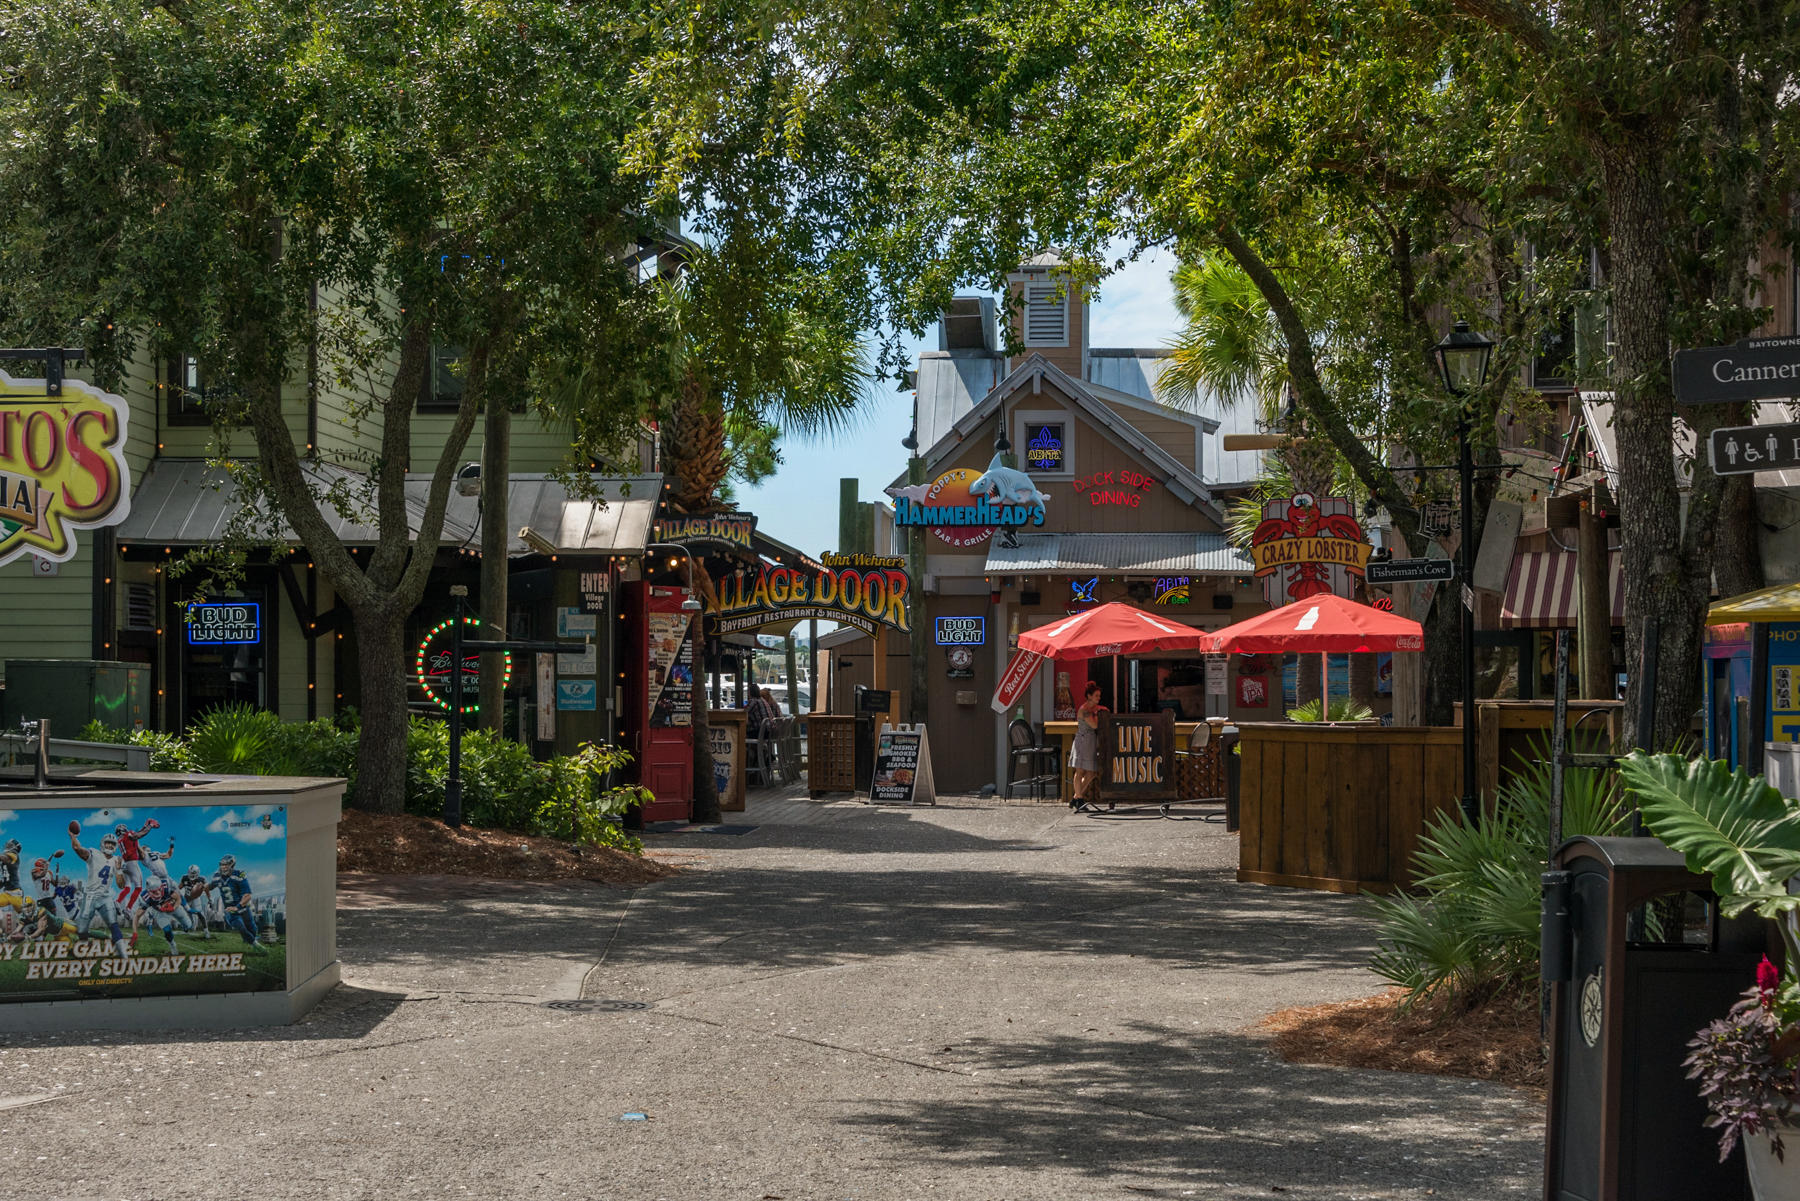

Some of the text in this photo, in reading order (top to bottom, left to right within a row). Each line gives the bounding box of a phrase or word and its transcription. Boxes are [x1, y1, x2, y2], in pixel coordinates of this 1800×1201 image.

[928, 471, 967, 500] POPPY'S
[1073, 470, 1155, 493] DOCK SIDE
[1090, 491, 1141, 508] DINING
[653, 518, 754, 549] VILLAGE DOOR
[934, 528, 951, 543] BAR
[964, 528, 993, 546] GRILLE
[820, 551, 905, 568] John Wehner's
[1262, 541, 1360, 564] CRAZY LOBSTER
[1372, 564, 1446, 578] Fisherman's Cove
[581, 573, 609, 592] ENTER
[1154, 577, 1189, 598] ABITA
[809, 567, 911, 633] DOOR
[202, 607, 247, 623] BUD
[721, 608, 873, 632] BAYFRONT RESTAURANT & NIGHTCLUB
[944, 619, 976, 631] BUD
[193, 623, 256, 640] LIGHT
[938, 630, 982, 642] LIGHT
[1004, 651, 1035, 696] Red Strip
[1118, 726, 1153, 752] LIVE
[1112, 755, 1163, 783] MUSIC
[98, 865, 111, 885] 4
[222, 886, 234, 903] 3
[20, 941, 69, 960] LIVE
[26, 953, 246, 980] EVERY SUNDAY HERE.
